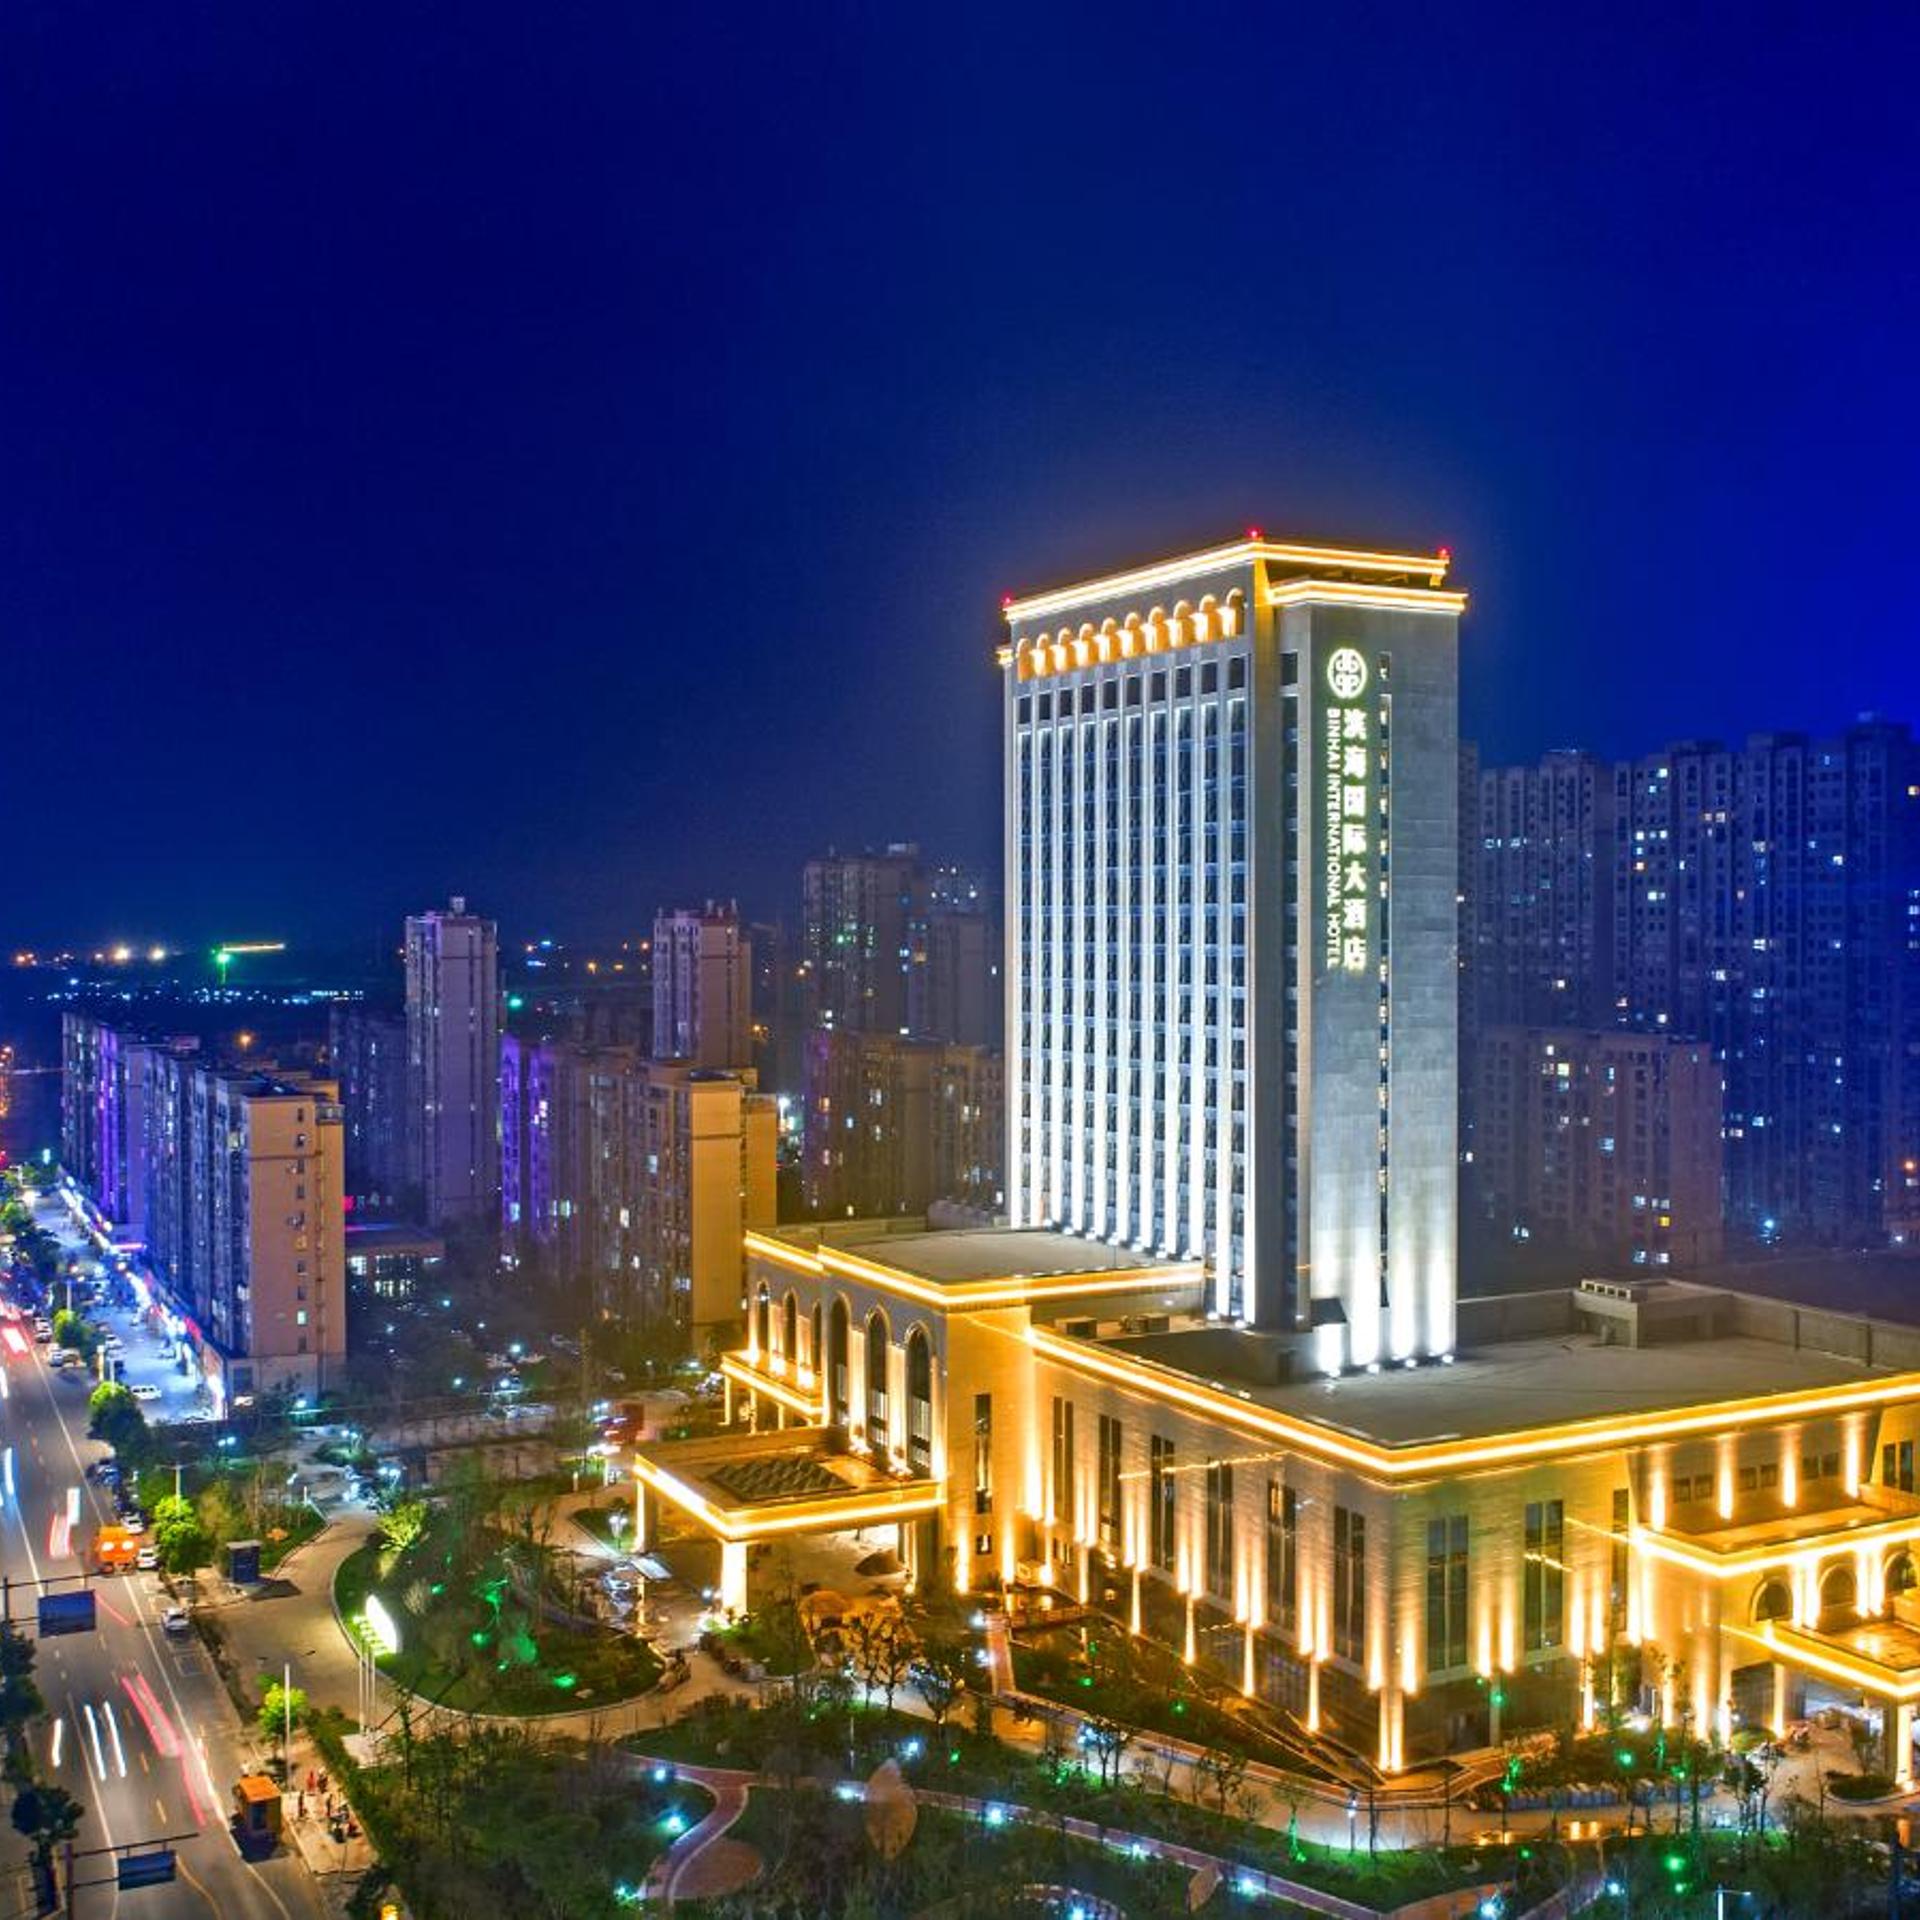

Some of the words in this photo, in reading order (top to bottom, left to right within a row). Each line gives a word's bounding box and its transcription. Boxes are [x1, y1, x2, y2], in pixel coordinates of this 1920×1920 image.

[1327, 707, 1341, 769] BINHAI
[1327, 773, 1341, 908] INTERNATIONAL
[1327, 913, 1341, 970] HOTEL
